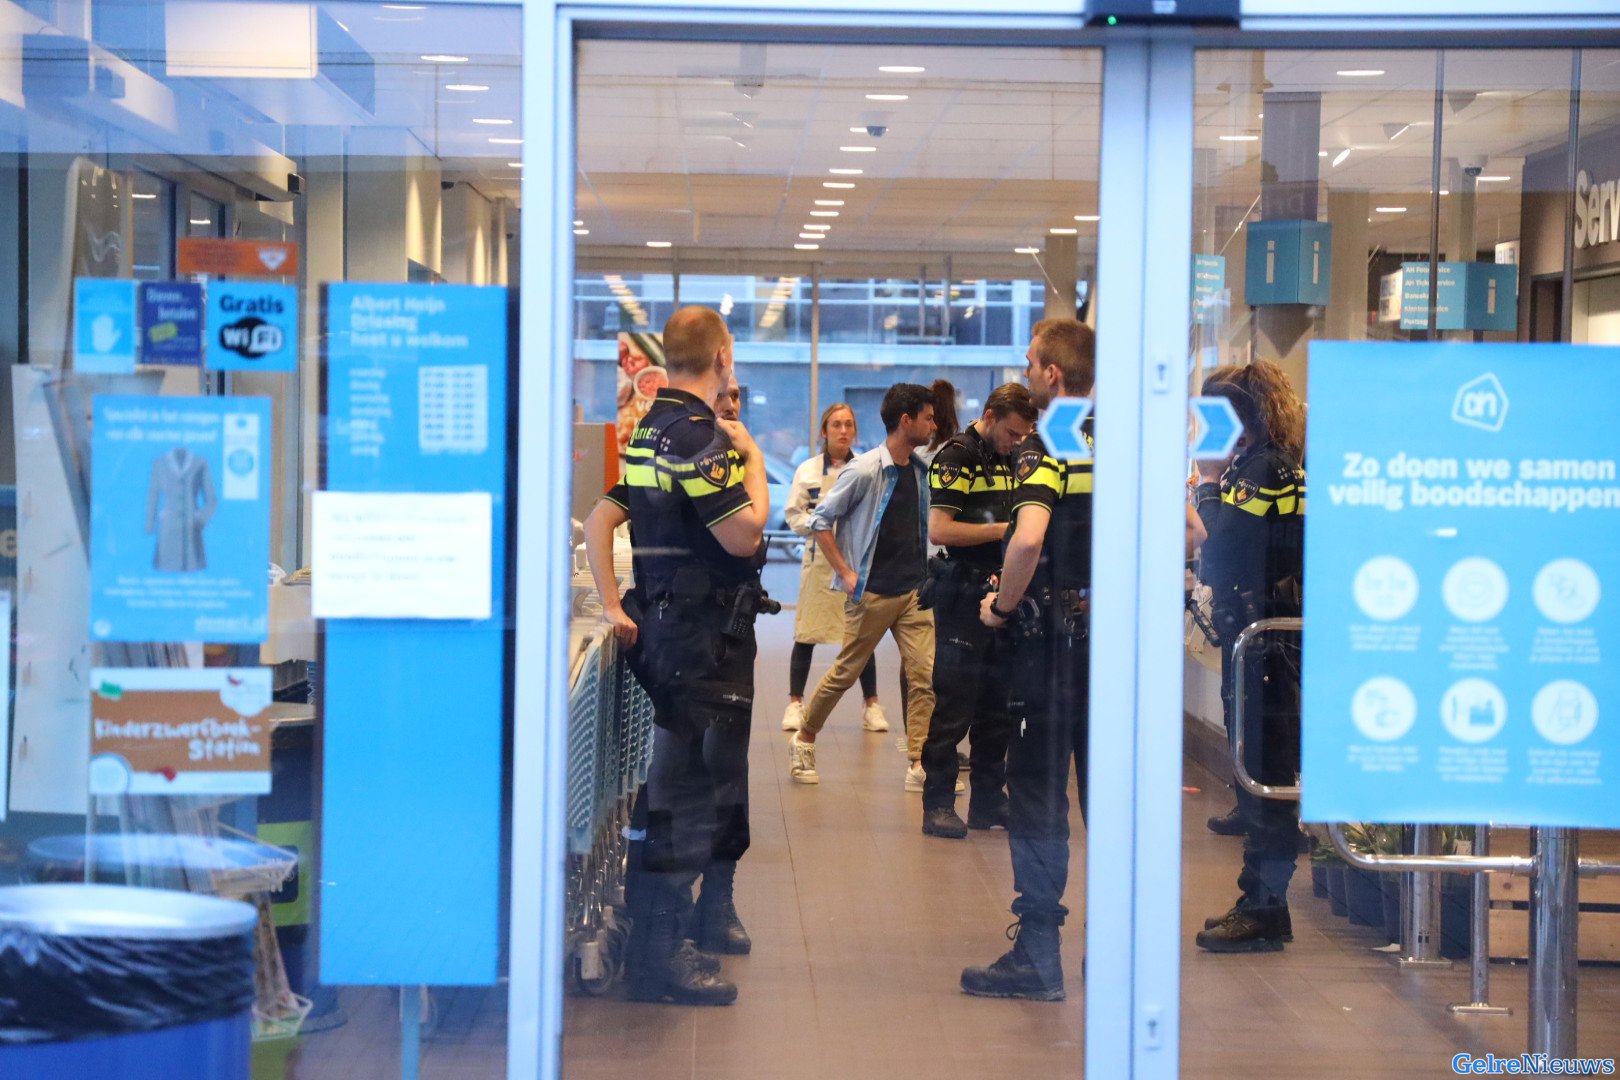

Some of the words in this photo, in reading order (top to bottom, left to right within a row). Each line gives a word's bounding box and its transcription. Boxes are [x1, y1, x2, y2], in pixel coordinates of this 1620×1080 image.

[219, 293, 284, 314] Gratis
[1342, 452, 1381, 479] Zo
[1387, 451, 1458, 479] doen
[1465, 458, 1512, 480] we
[1519, 458, 1617, 481] samen
[1329, 479, 1404, 511] veilig
[1410, 480, 1620, 513] boodschappen
